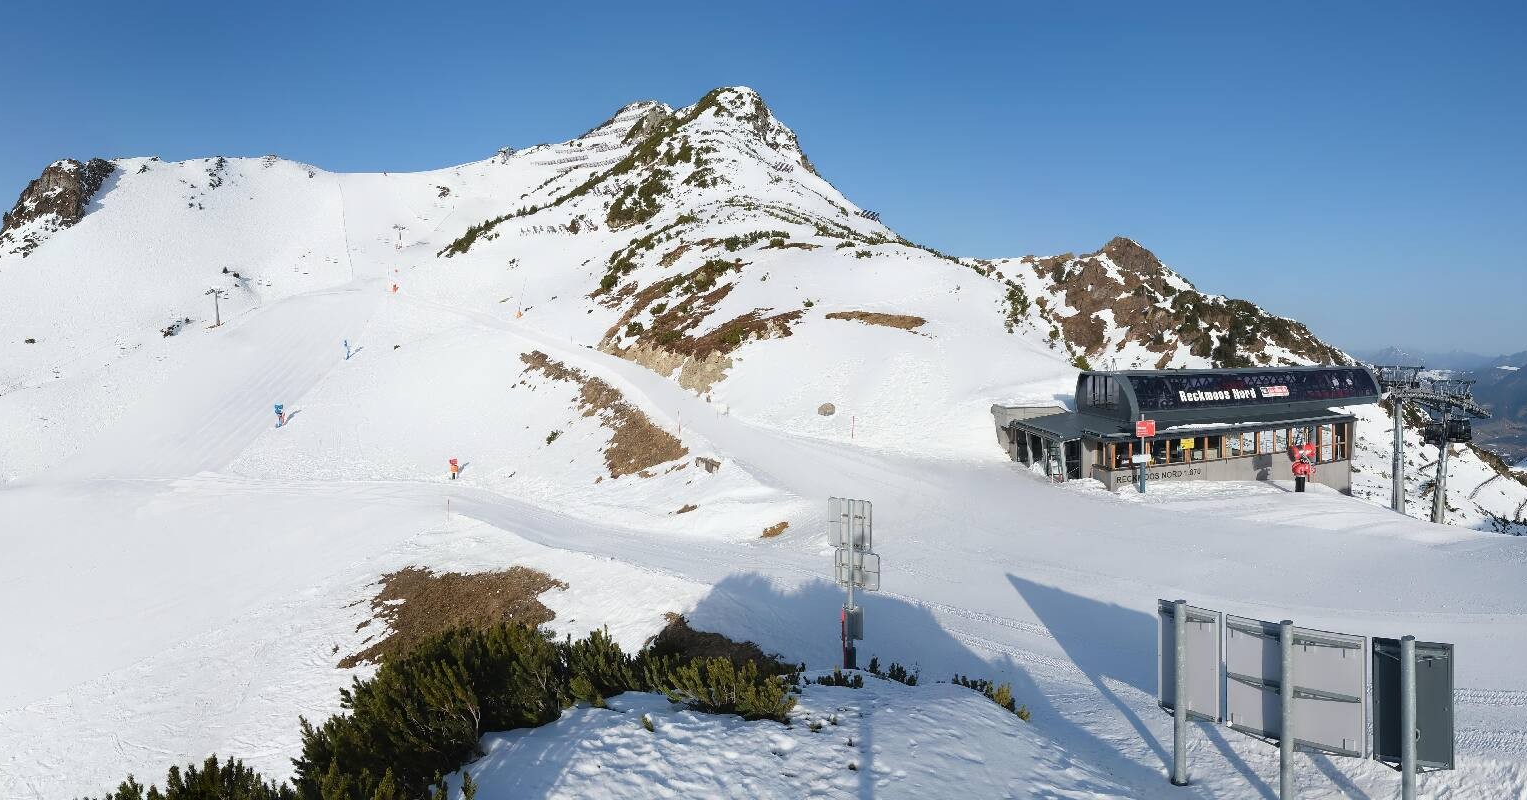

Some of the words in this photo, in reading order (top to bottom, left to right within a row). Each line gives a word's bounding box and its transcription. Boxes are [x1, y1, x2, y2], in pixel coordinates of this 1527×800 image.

[1179, 390, 1231, 402] Reckmoos
[1232, 388, 1257, 399] Nord
[1116, 472, 1160, 483] RECKOOS
[1161, 470, 1183, 479] NORD
